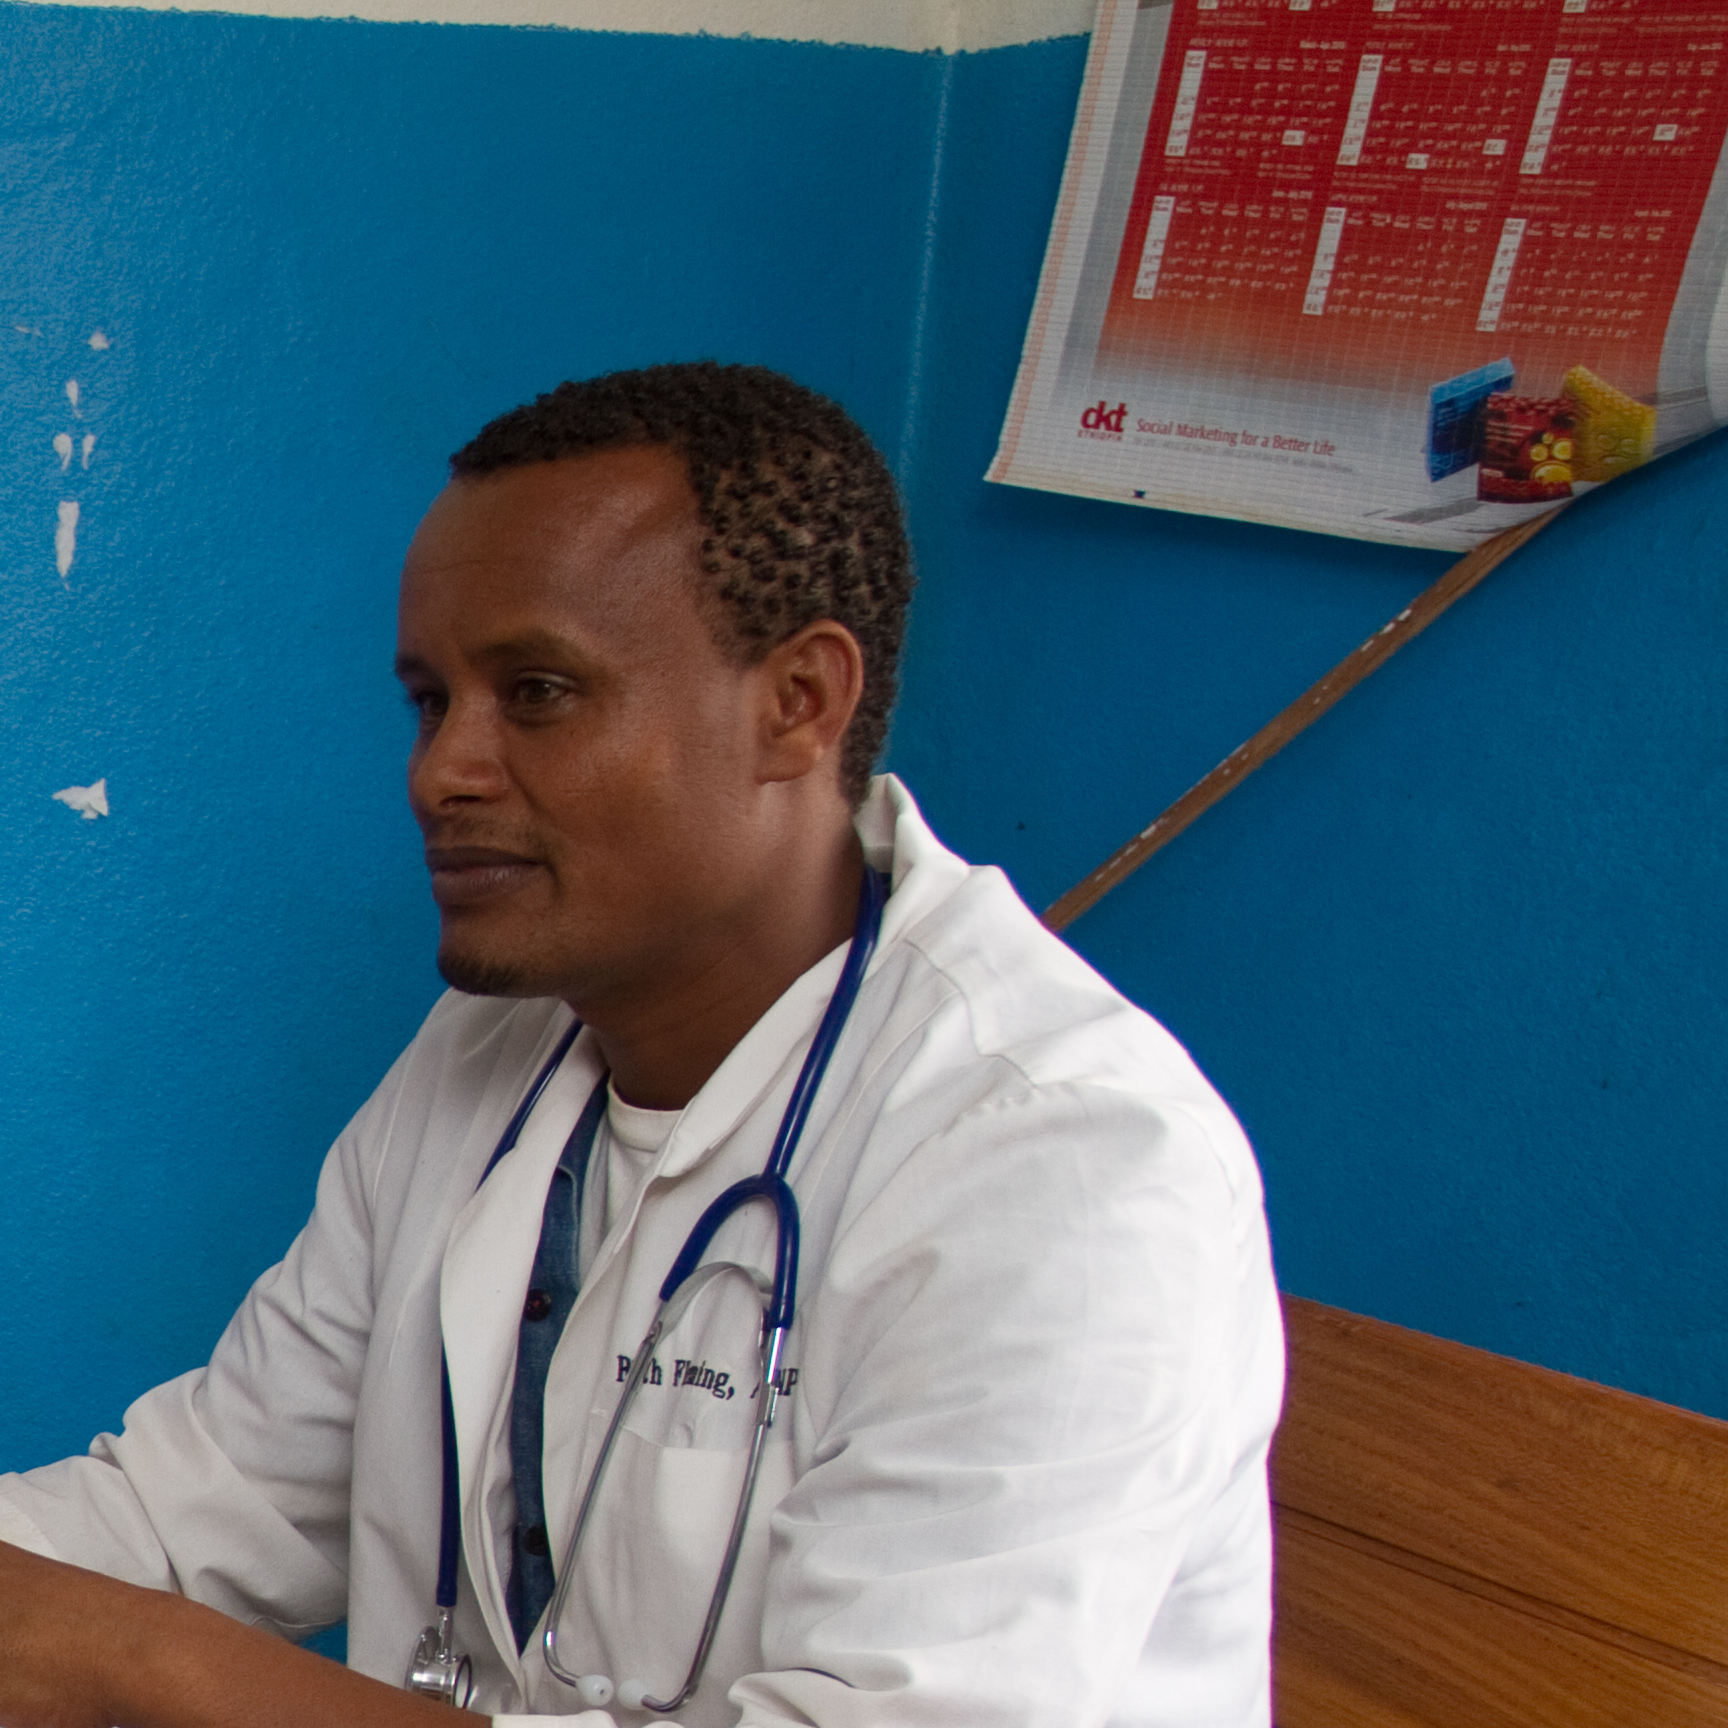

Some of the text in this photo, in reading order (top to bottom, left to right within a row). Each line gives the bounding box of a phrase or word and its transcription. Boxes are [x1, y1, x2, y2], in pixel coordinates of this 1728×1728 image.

[1080, 400, 1128, 432] dkt
[1136, 418, 1172, 436] Social
[1176, 424, 1237, 446] Marketing
[1241, 430, 1258, 446] for
[1261, 436, 1268, 447] a
[1272, 434, 1310, 452] Better
[1312, 440, 1336, 456] Life
